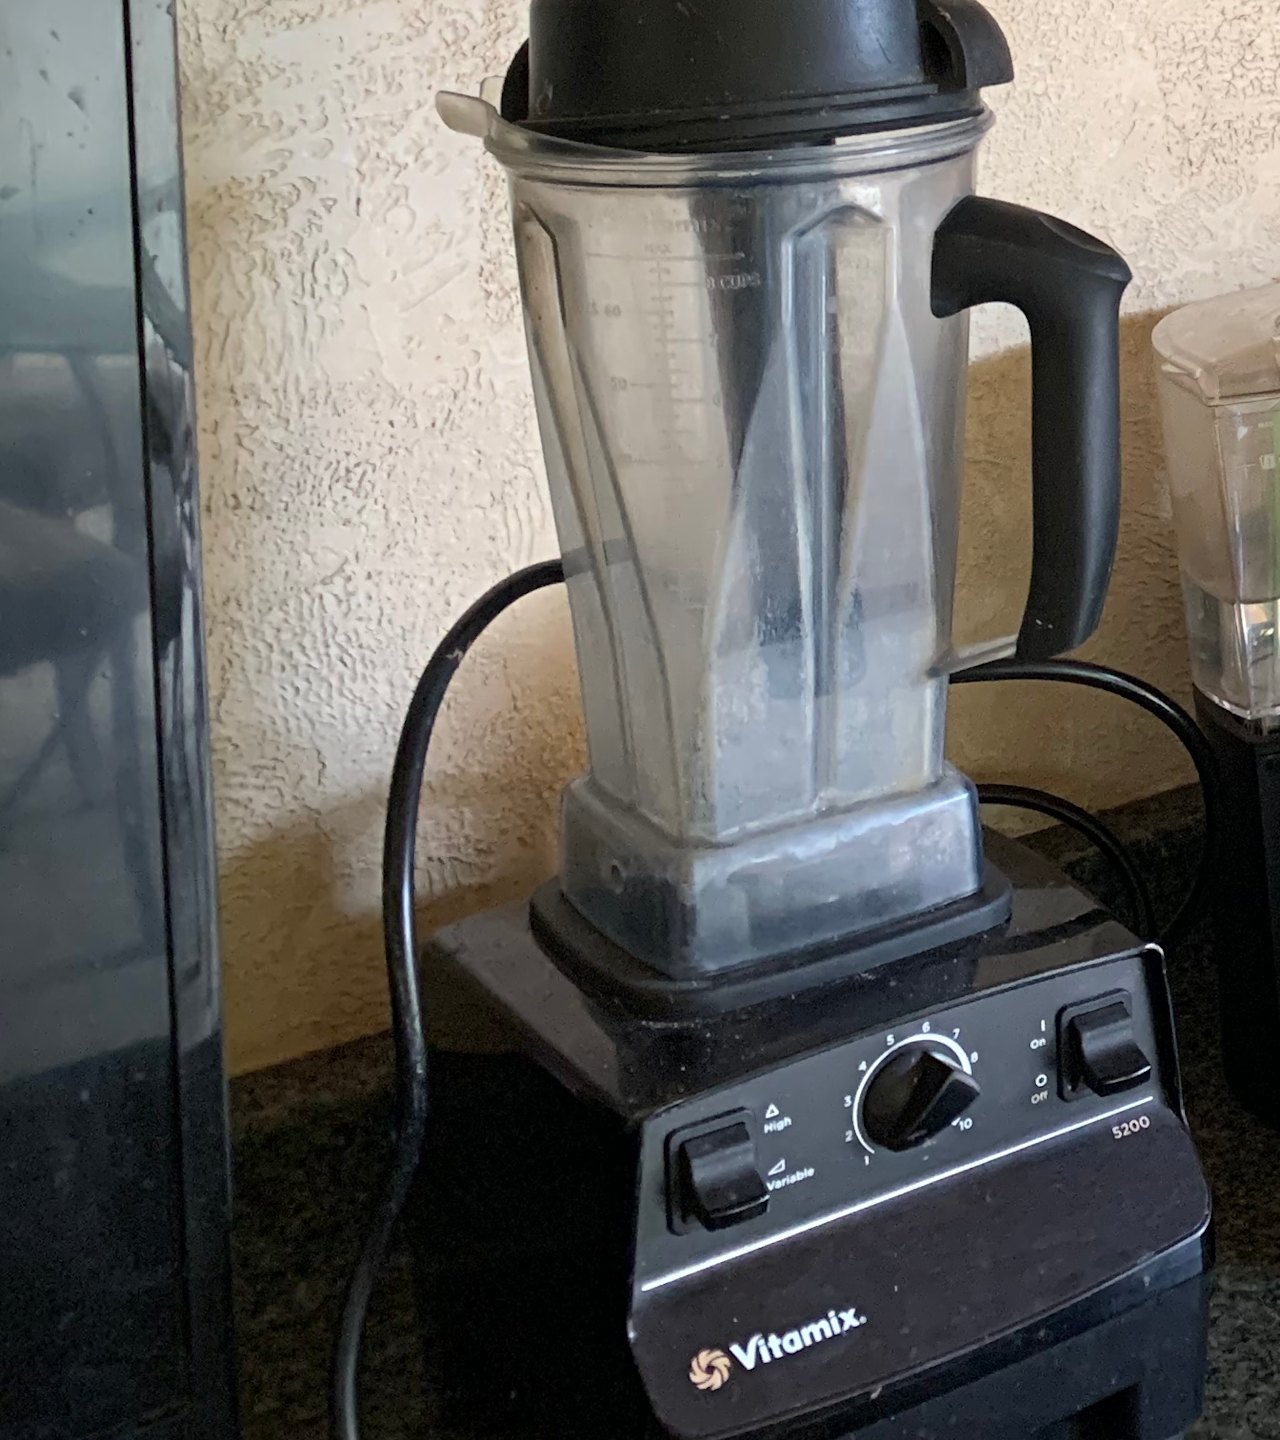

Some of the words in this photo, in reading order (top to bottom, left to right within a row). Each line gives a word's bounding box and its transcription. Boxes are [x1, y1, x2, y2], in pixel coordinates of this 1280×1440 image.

[922, 1022, 931, 1032] 6
[952, 1028, 961, 1039] 7
[886, 1034, 895, 1046] 5
[1029, 1037, 1047, 1050] On
[970, 1051, 979, 1063] 8
[858, 1060, 867, 1072] 4
[844, 1095, 852, 1108] 3
[1030, 1090, 1049, 1105] Off
[763, 1116, 793, 1134] High
[958, 1117, 973, 1131] 10
[1111, 1115, 1151, 1140] 5200
[844, 1130, 853, 1142] 2
[864, 1155, 870, 1166] 1
[766, 1167, 816, 1192] Variable
[728, 1307, 860, 1371] Vitamix
